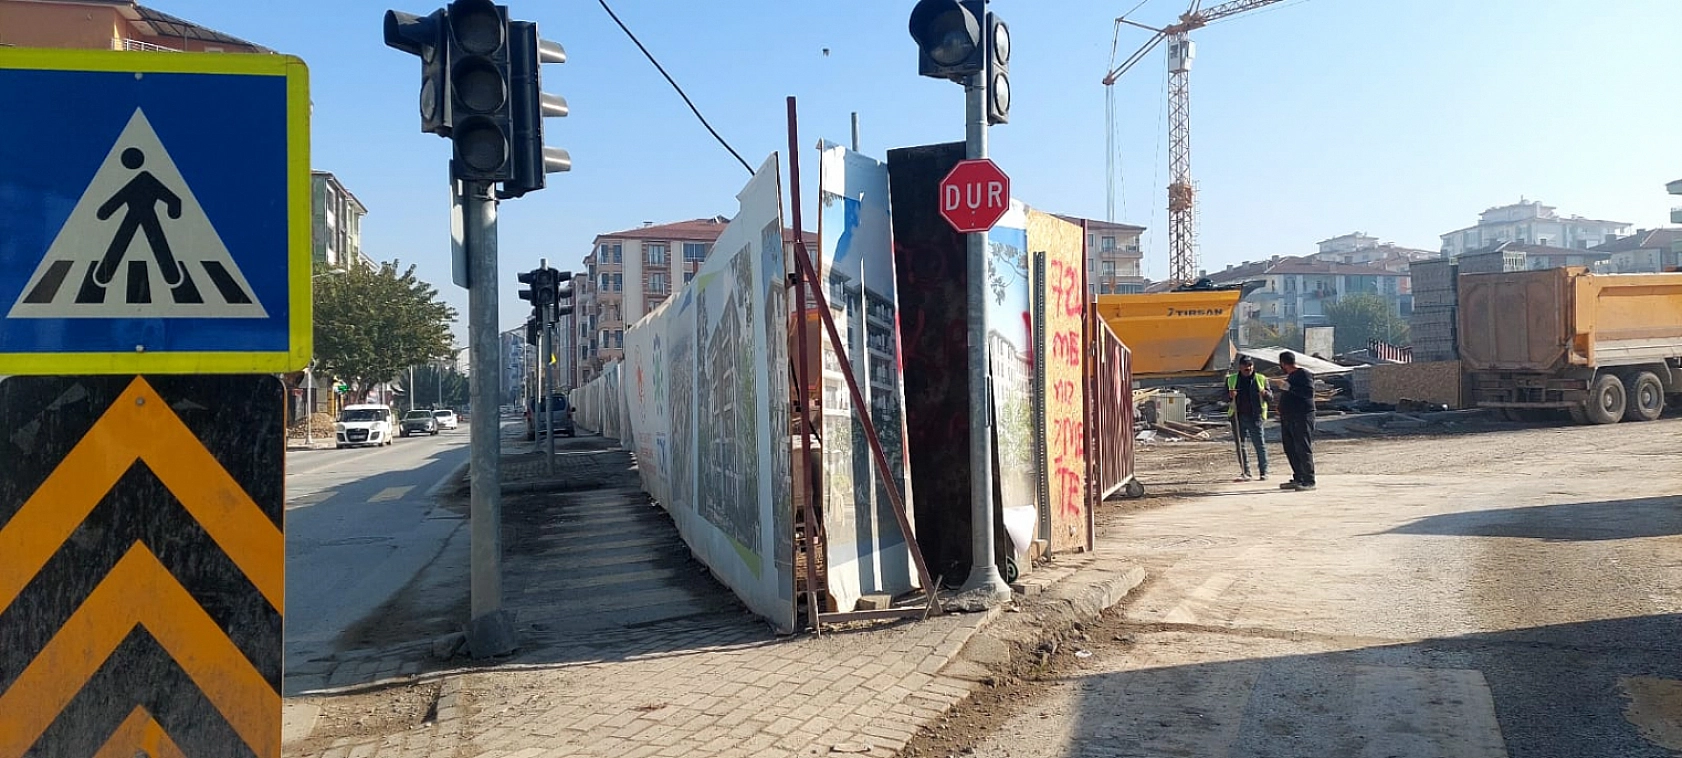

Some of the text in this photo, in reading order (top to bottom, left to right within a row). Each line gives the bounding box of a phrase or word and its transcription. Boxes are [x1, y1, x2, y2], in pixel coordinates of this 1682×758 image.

[945, 181, 1003, 211] DUR
[1175, 308, 1223, 317] TIRSAN
[1055, 467, 1080, 518] TE
